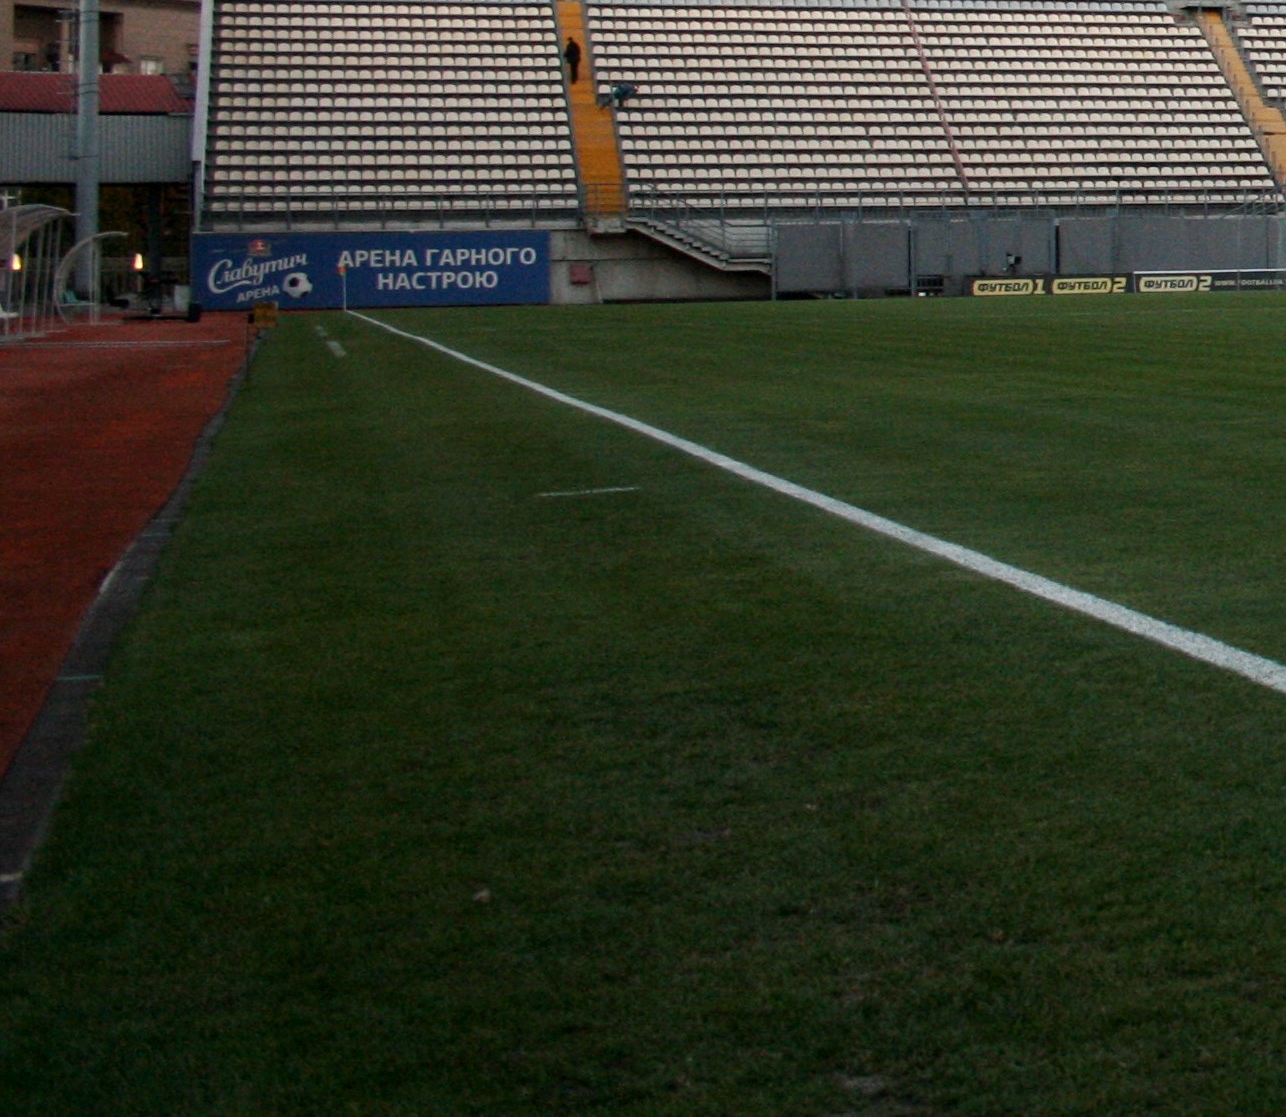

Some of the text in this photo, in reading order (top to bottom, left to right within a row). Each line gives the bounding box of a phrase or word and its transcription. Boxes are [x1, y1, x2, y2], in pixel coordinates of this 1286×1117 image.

[338, 246, 537, 268] АРЕНА ГАРНОГО
[208, 253, 307, 294] Славутич
[377, 270, 498, 290] НАСТРОЮ
[977, 282, 1029, 292] ФУТБОЛ
[1057, 281, 1107, 291] ФУТБОЛ
[1144, 275, 1212, 291] ФУТБОЛ 2
[237, 285, 281, 303] АРЕНА
